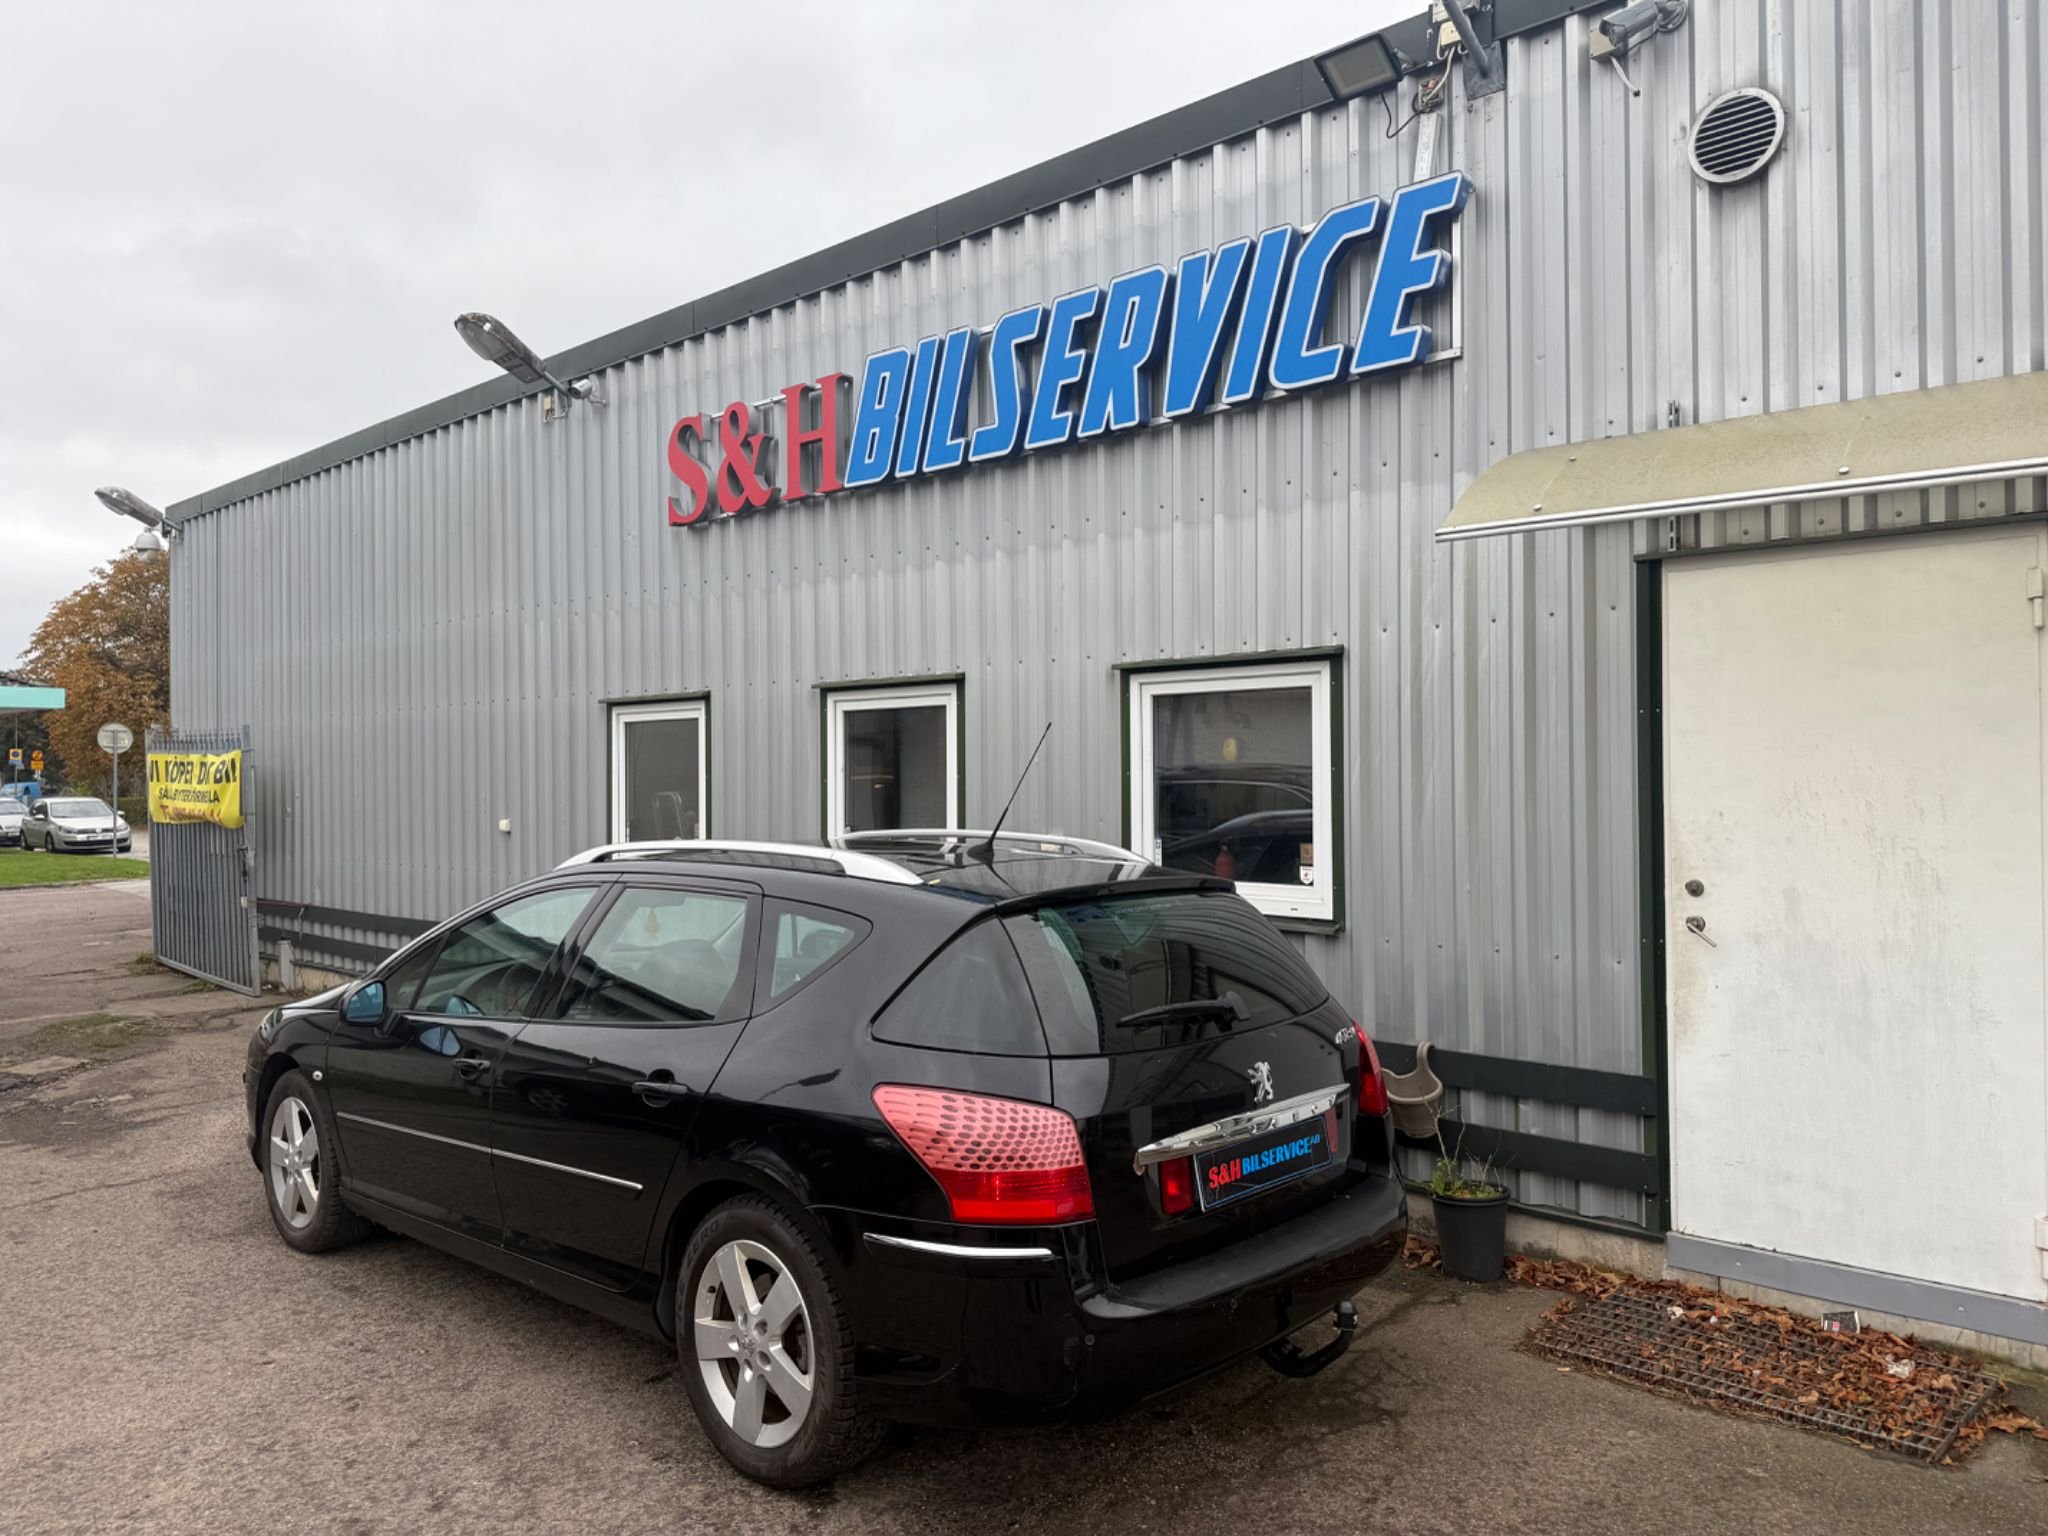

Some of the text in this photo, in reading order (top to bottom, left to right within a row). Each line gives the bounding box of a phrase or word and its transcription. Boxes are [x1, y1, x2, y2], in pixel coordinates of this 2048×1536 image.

[666, 169, 1474, 527] S&H BILSERVICE
[1209, 1158, 1241, 1189] S&H
[1241, 1136, 1312, 1176] BILSERVICE
